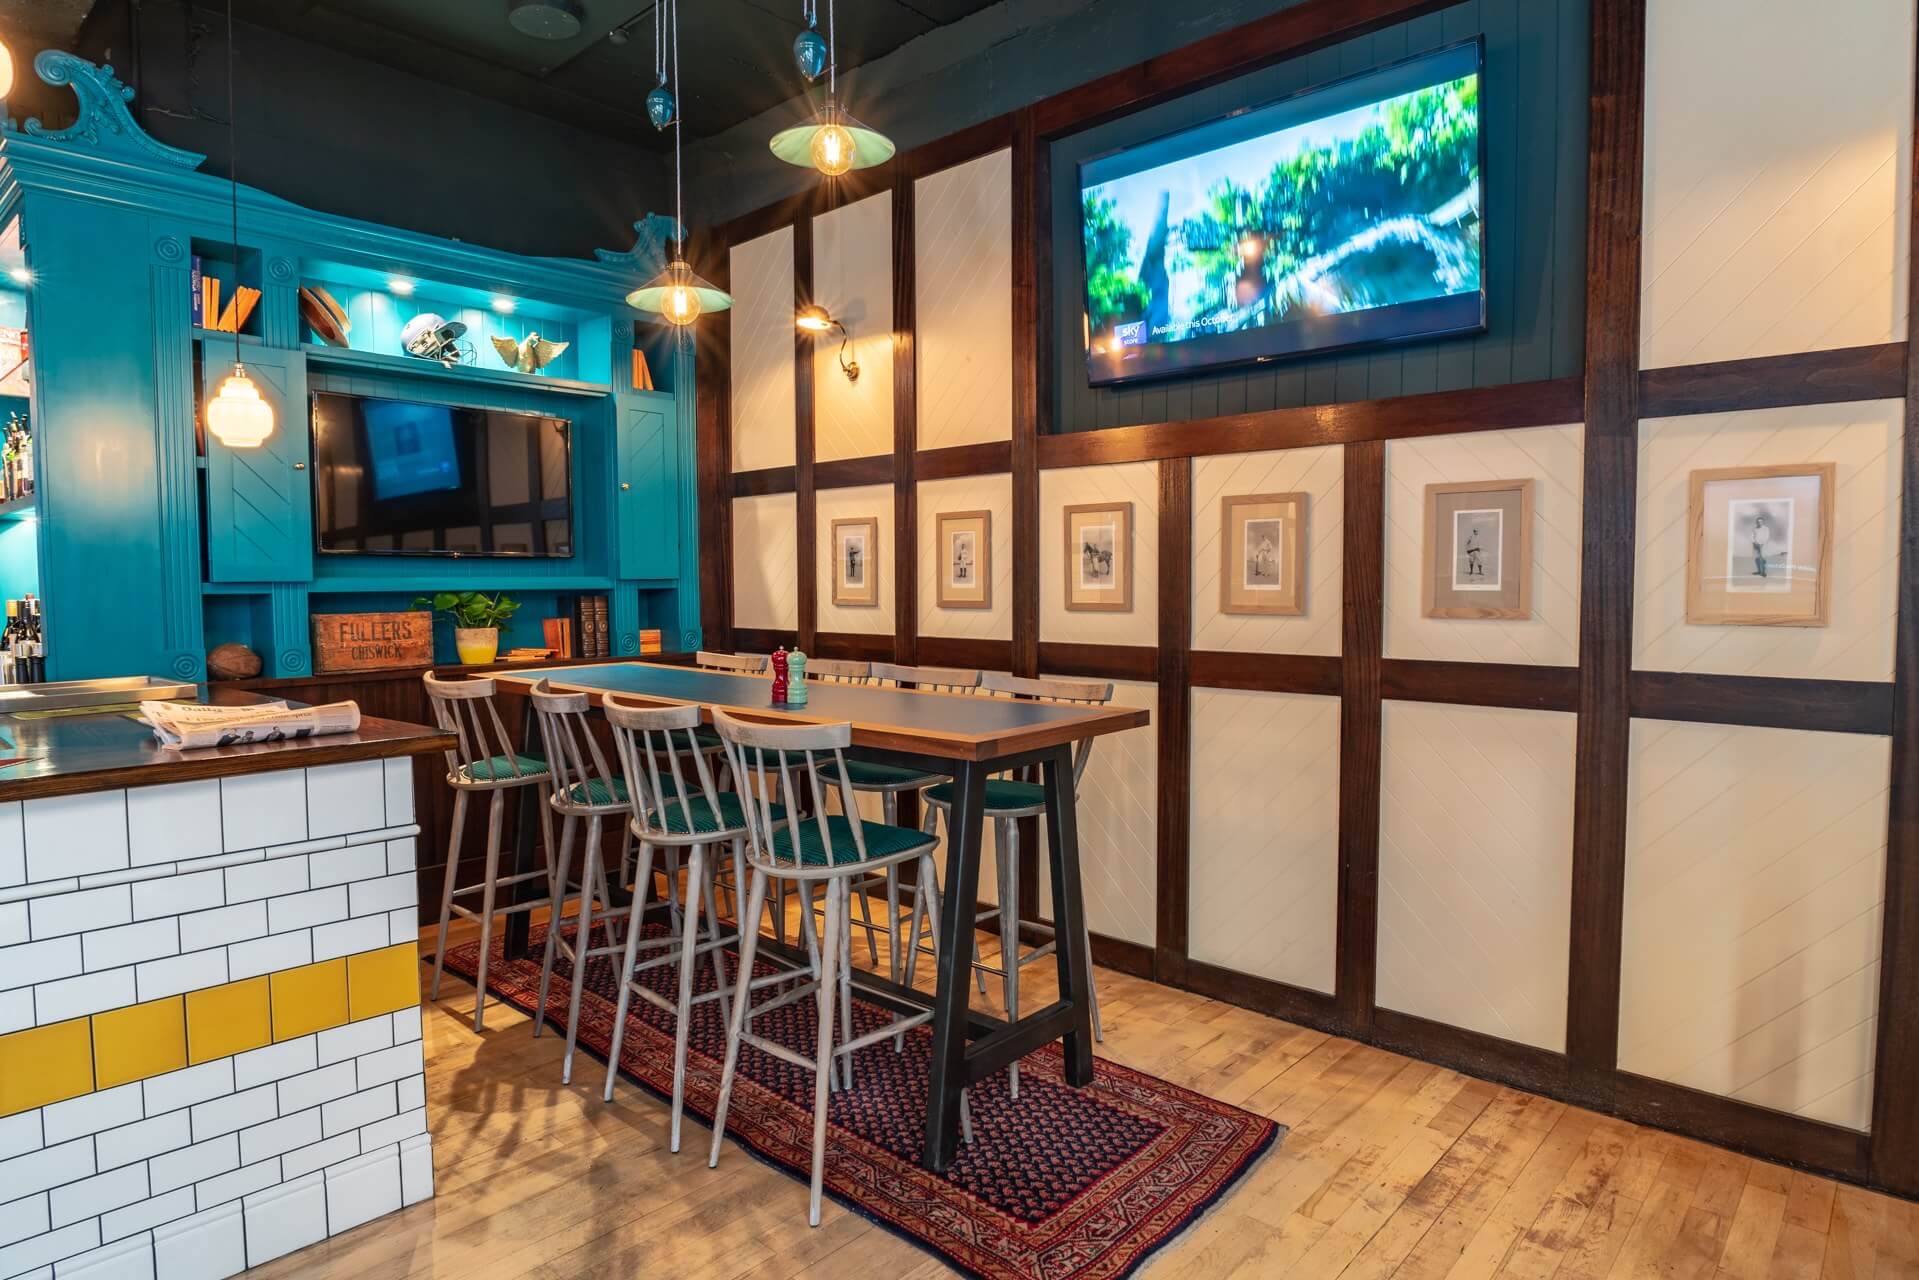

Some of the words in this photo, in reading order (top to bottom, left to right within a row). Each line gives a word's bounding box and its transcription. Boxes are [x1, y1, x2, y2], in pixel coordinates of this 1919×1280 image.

[1122, 324, 1139, 338] sky
[1185, 319, 1200, 329] this
[351, 643, 402, 660] CHISWICK
